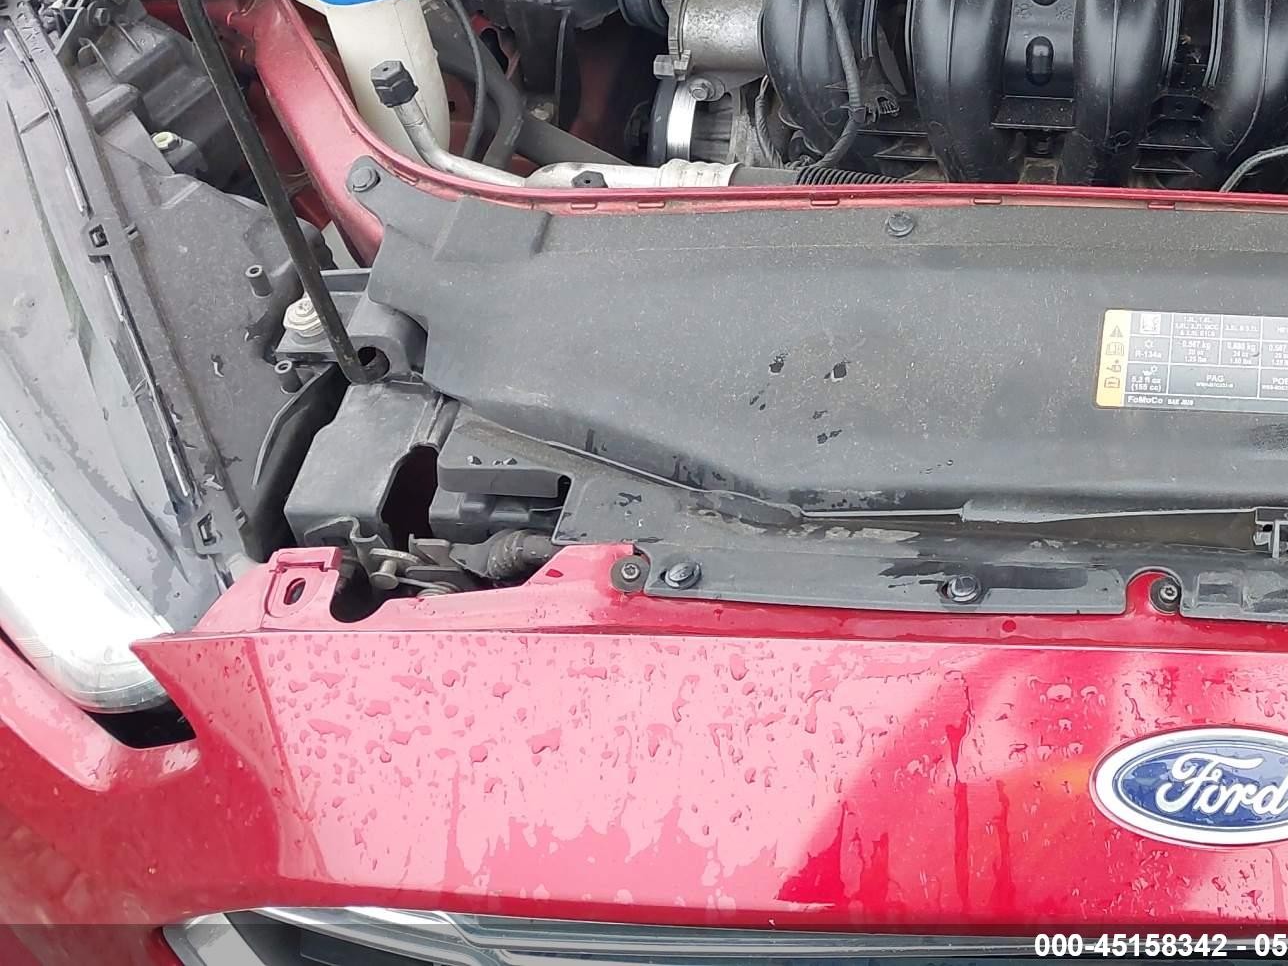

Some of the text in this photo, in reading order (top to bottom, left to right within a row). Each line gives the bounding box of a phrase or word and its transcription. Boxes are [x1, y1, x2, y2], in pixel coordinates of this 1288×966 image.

[1135, 350, 1162, 359] R-134a
[1206, 374, 1225, 382] PAG
[1127, 395, 1163, 404] FoMoCo
